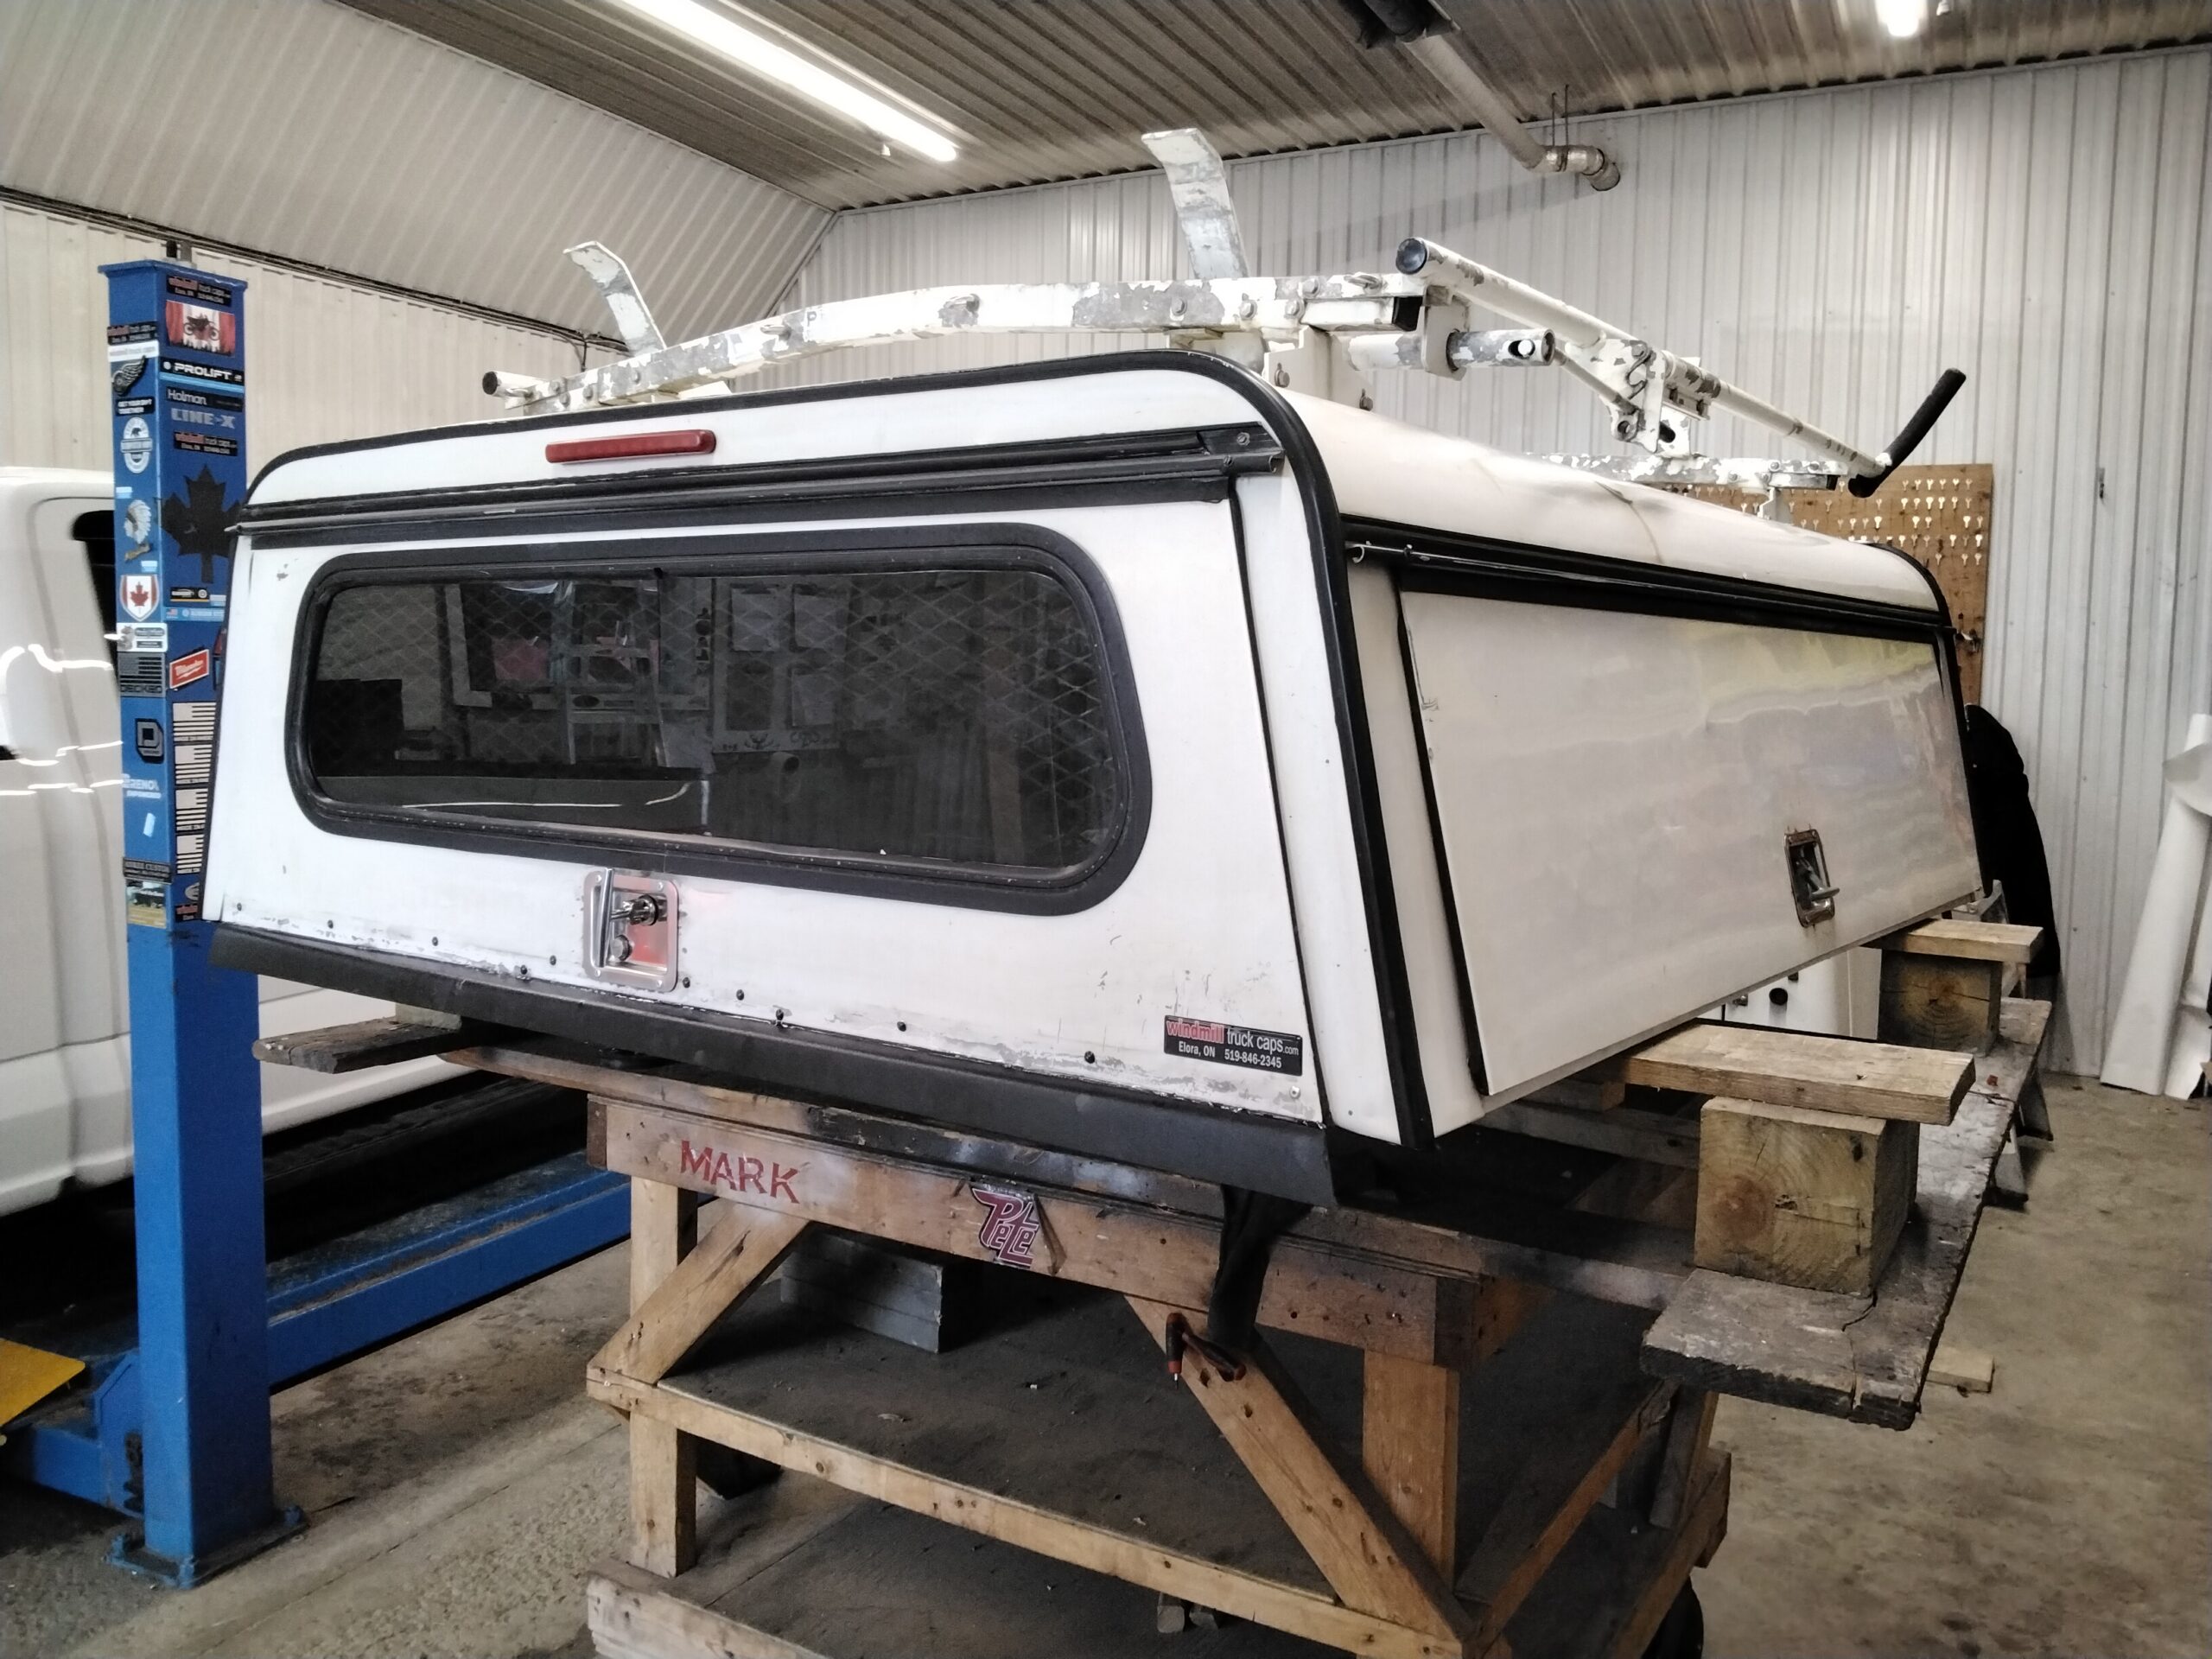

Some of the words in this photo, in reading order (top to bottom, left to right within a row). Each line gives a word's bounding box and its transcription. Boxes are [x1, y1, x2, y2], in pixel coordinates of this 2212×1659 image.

[174, 362, 232, 380] PROLIFT
[168, 388, 207, 405] Holman
[1166, 1019, 1224, 1045] windmill
[1227, 1027, 1254, 1048] truck
[1179, 1041, 1201, 1057] Elora,
[1203, 1045, 1216, 1058] ON
[1224, 1049, 1282, 1069] 519-846-2345
[681, 1140, 800, 1204] MARK
